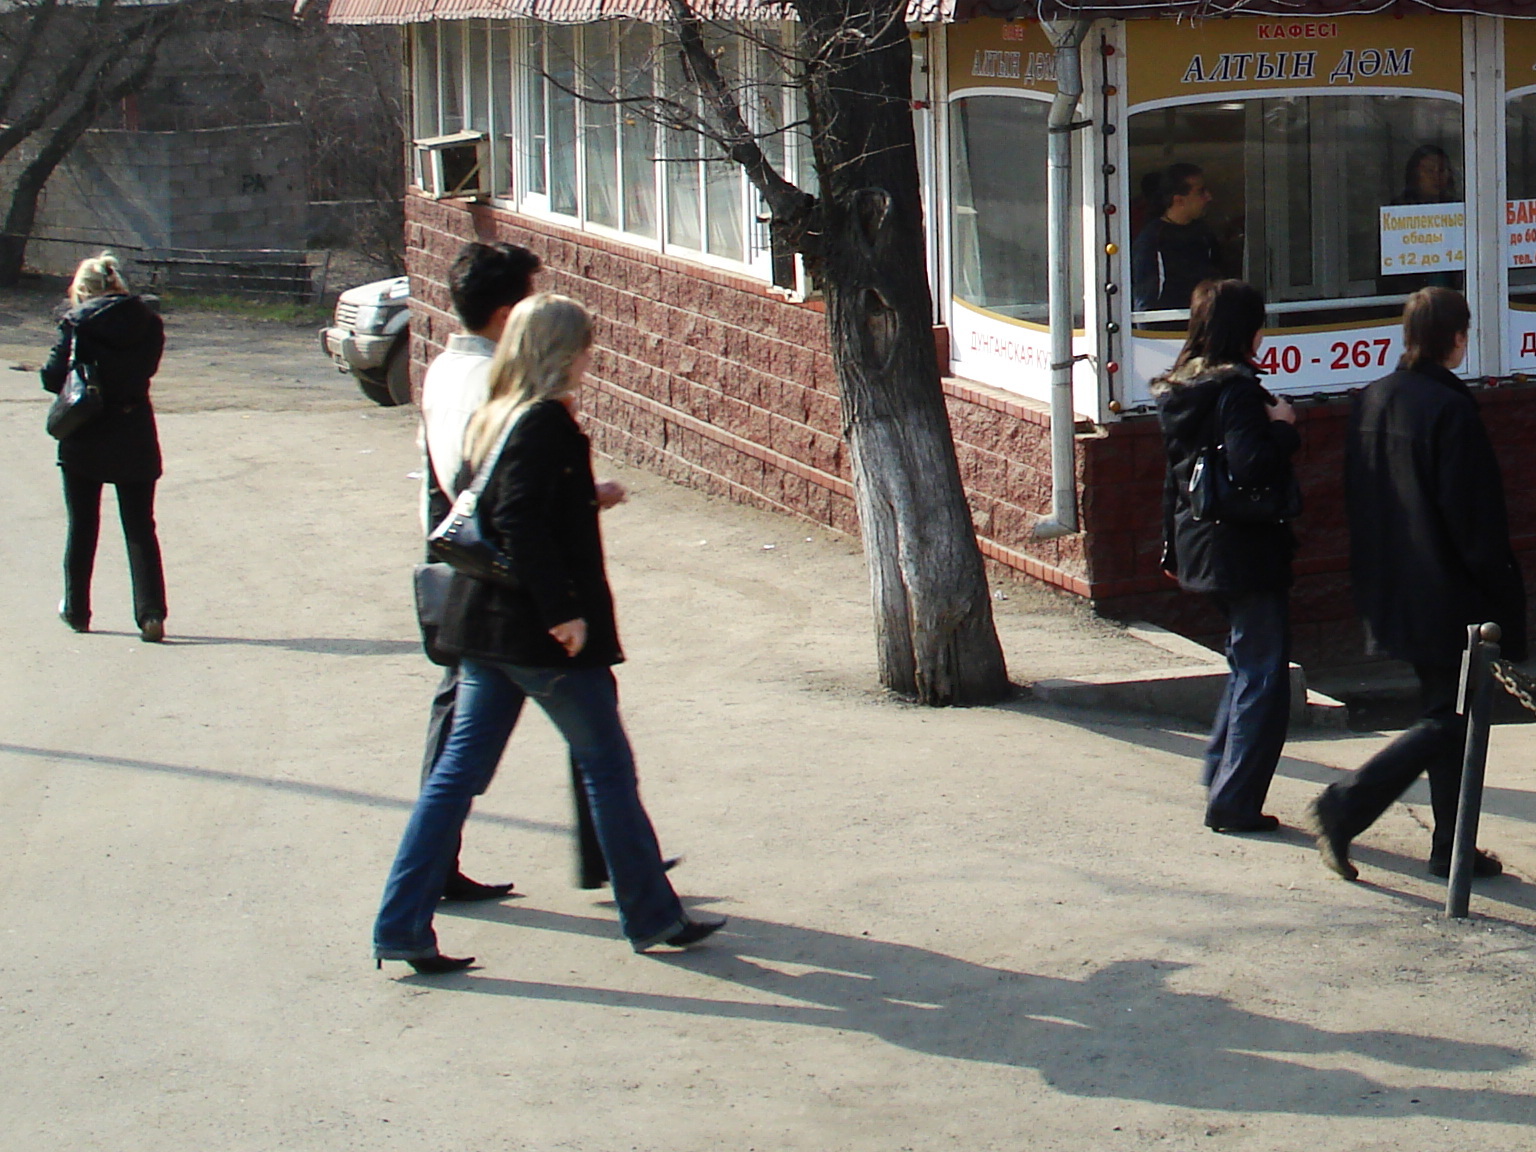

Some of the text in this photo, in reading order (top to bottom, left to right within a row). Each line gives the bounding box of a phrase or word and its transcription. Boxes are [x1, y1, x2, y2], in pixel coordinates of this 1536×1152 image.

[1258, 23, 1338, 40] КАФЕСІ
[971, 49, 1021, 79] АЛТЫН
[1181, 48, 1414, 85] АЛТЫН ДӘМ
[1383, 211, 1464, 231] Комплексные
[1510, 233, 1523, 246] до
[1398, 252, 1417, 266] 12
[1421, 254, 1440, 266] до
[1446, 250, 1464, 263] 14
[971, 331, 1051, 370] ДУНГАНСКАЯ КУ
[1330, 338, 1392, 370] 267
